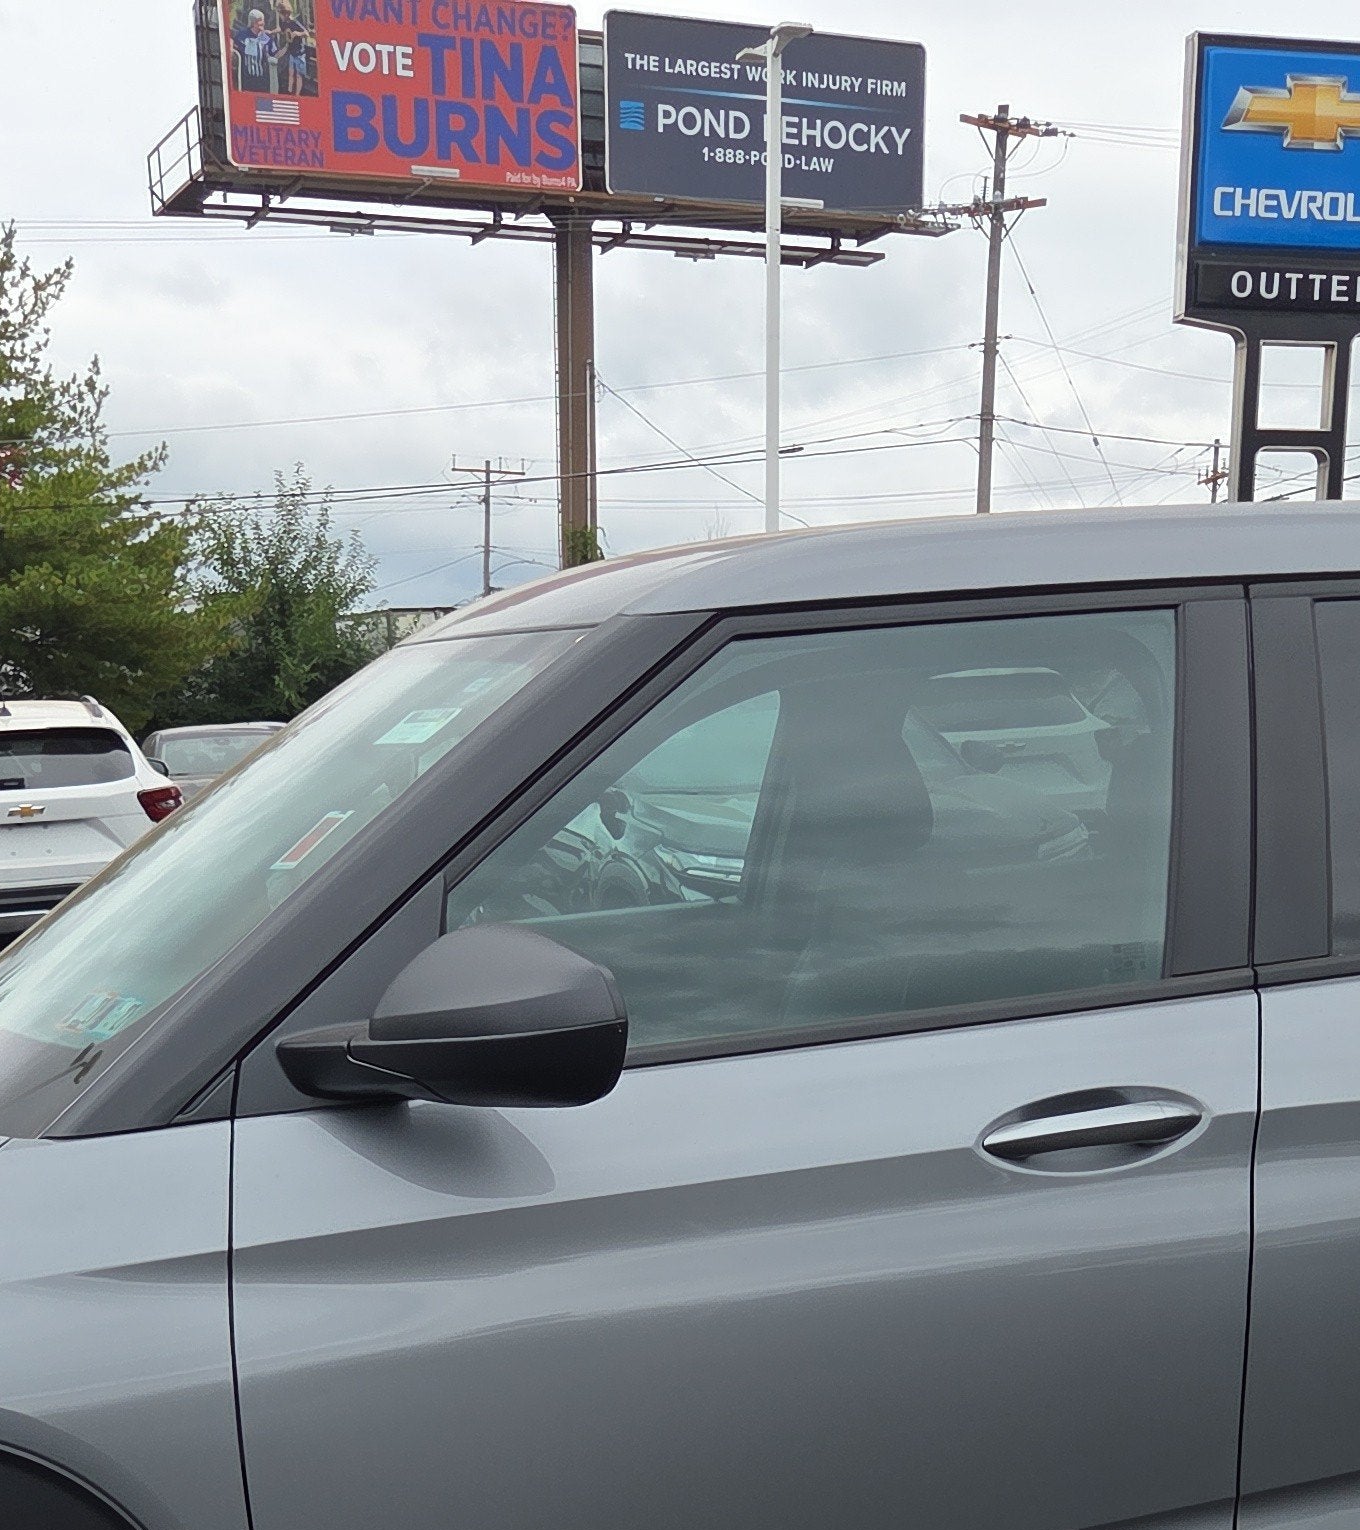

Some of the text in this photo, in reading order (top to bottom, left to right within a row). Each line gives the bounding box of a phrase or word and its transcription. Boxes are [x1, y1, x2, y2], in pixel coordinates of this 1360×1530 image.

[330, 0, 574, 41] WANT CHANGE?
[330, 33, 575, 108] VOTE TINA
[624, 52, 659, 72] THE
[665, 57, 741, 80] LARGEST
[802, 71, 863, 93] INJURY
[867, 78, 907, 98] FIRM
[232, 123, 322, 147] MILITARY
[331, 90, 577, 171] BURNS
[657, 103, 751, 140] POND
[236, 144, 324, 168] VETERAN
